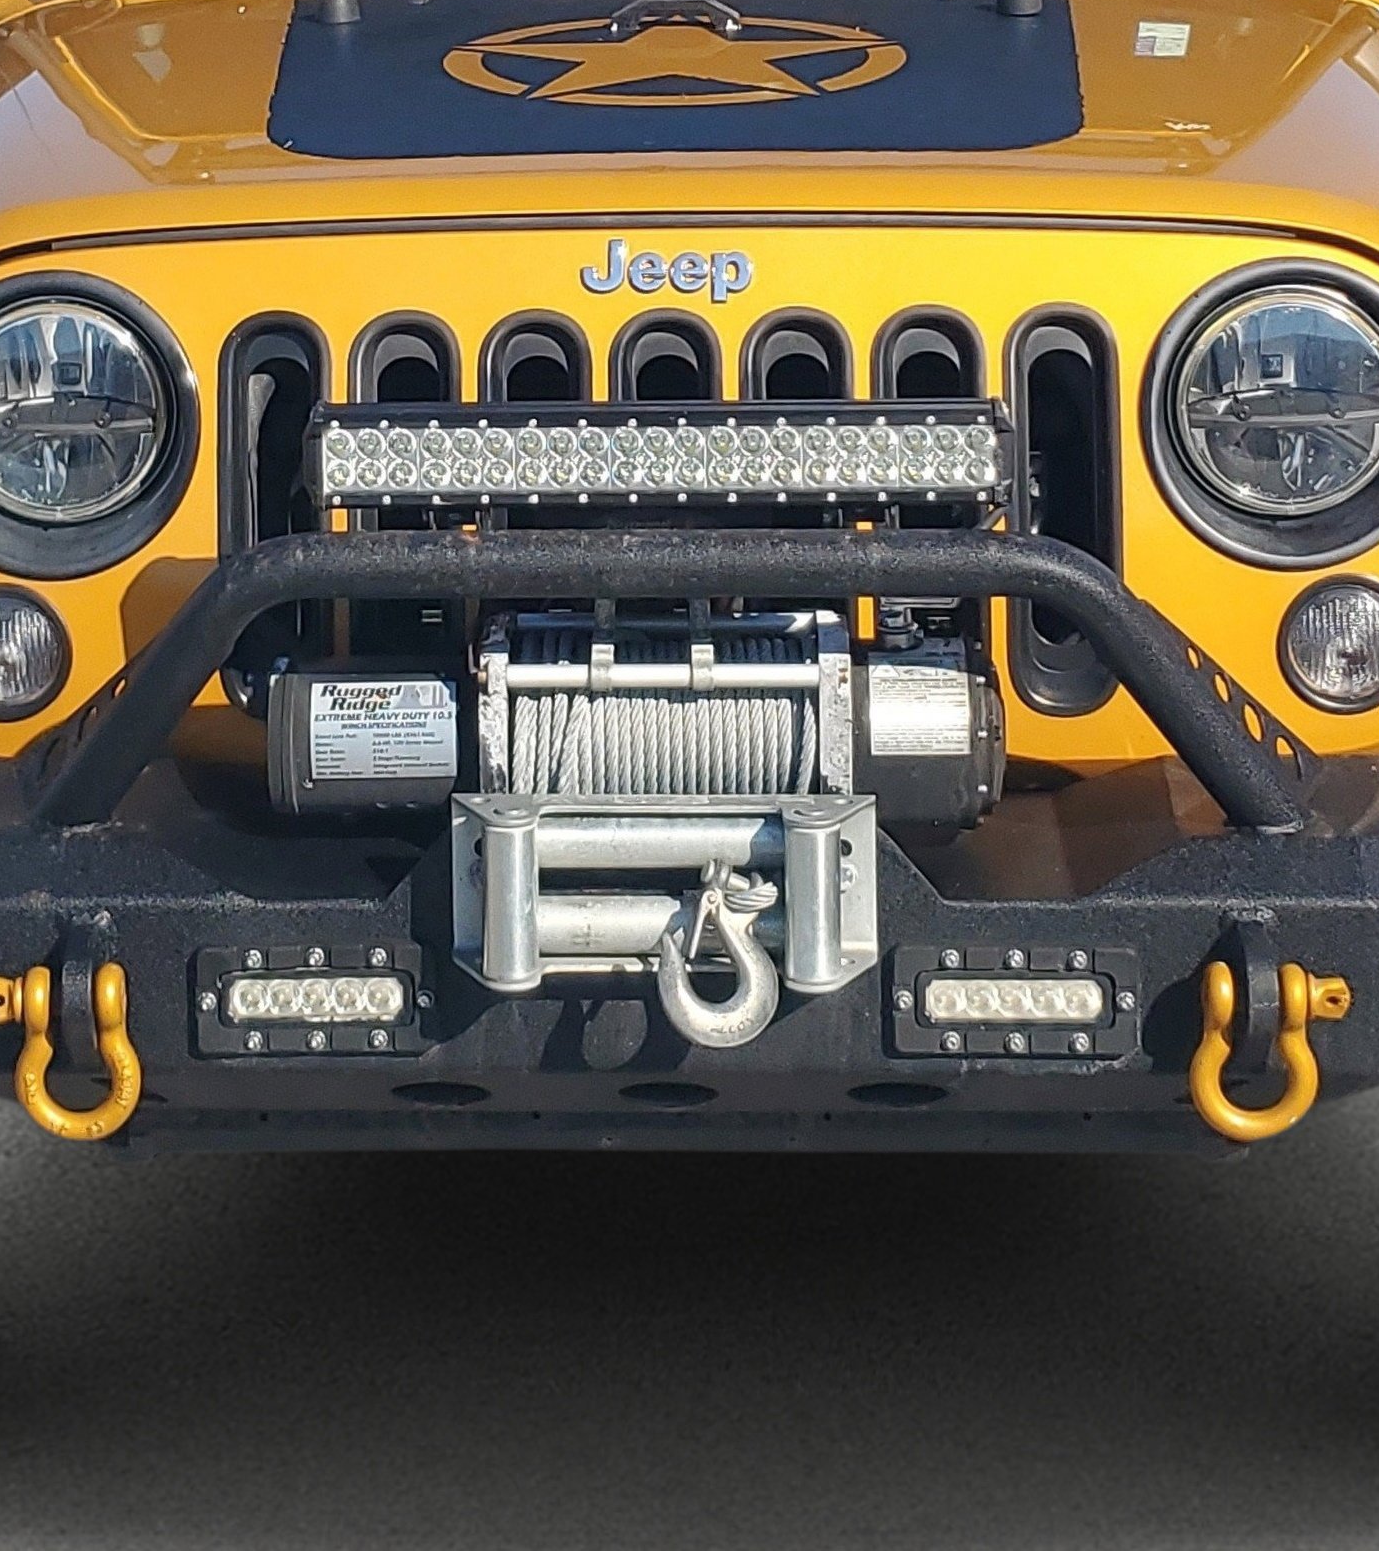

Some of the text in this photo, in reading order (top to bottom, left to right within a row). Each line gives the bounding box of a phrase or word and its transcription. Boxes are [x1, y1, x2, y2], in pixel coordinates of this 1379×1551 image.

[579, 238, 754, 303] Jeep
[320, 684, 403, 699] Rugged
[329, 697, 392, 712] Ridge
[314, 713, 362, 722] EXTREME
[364, 712, 400, 721] HEAVY
[402, 711, 429, 720] DUTY
